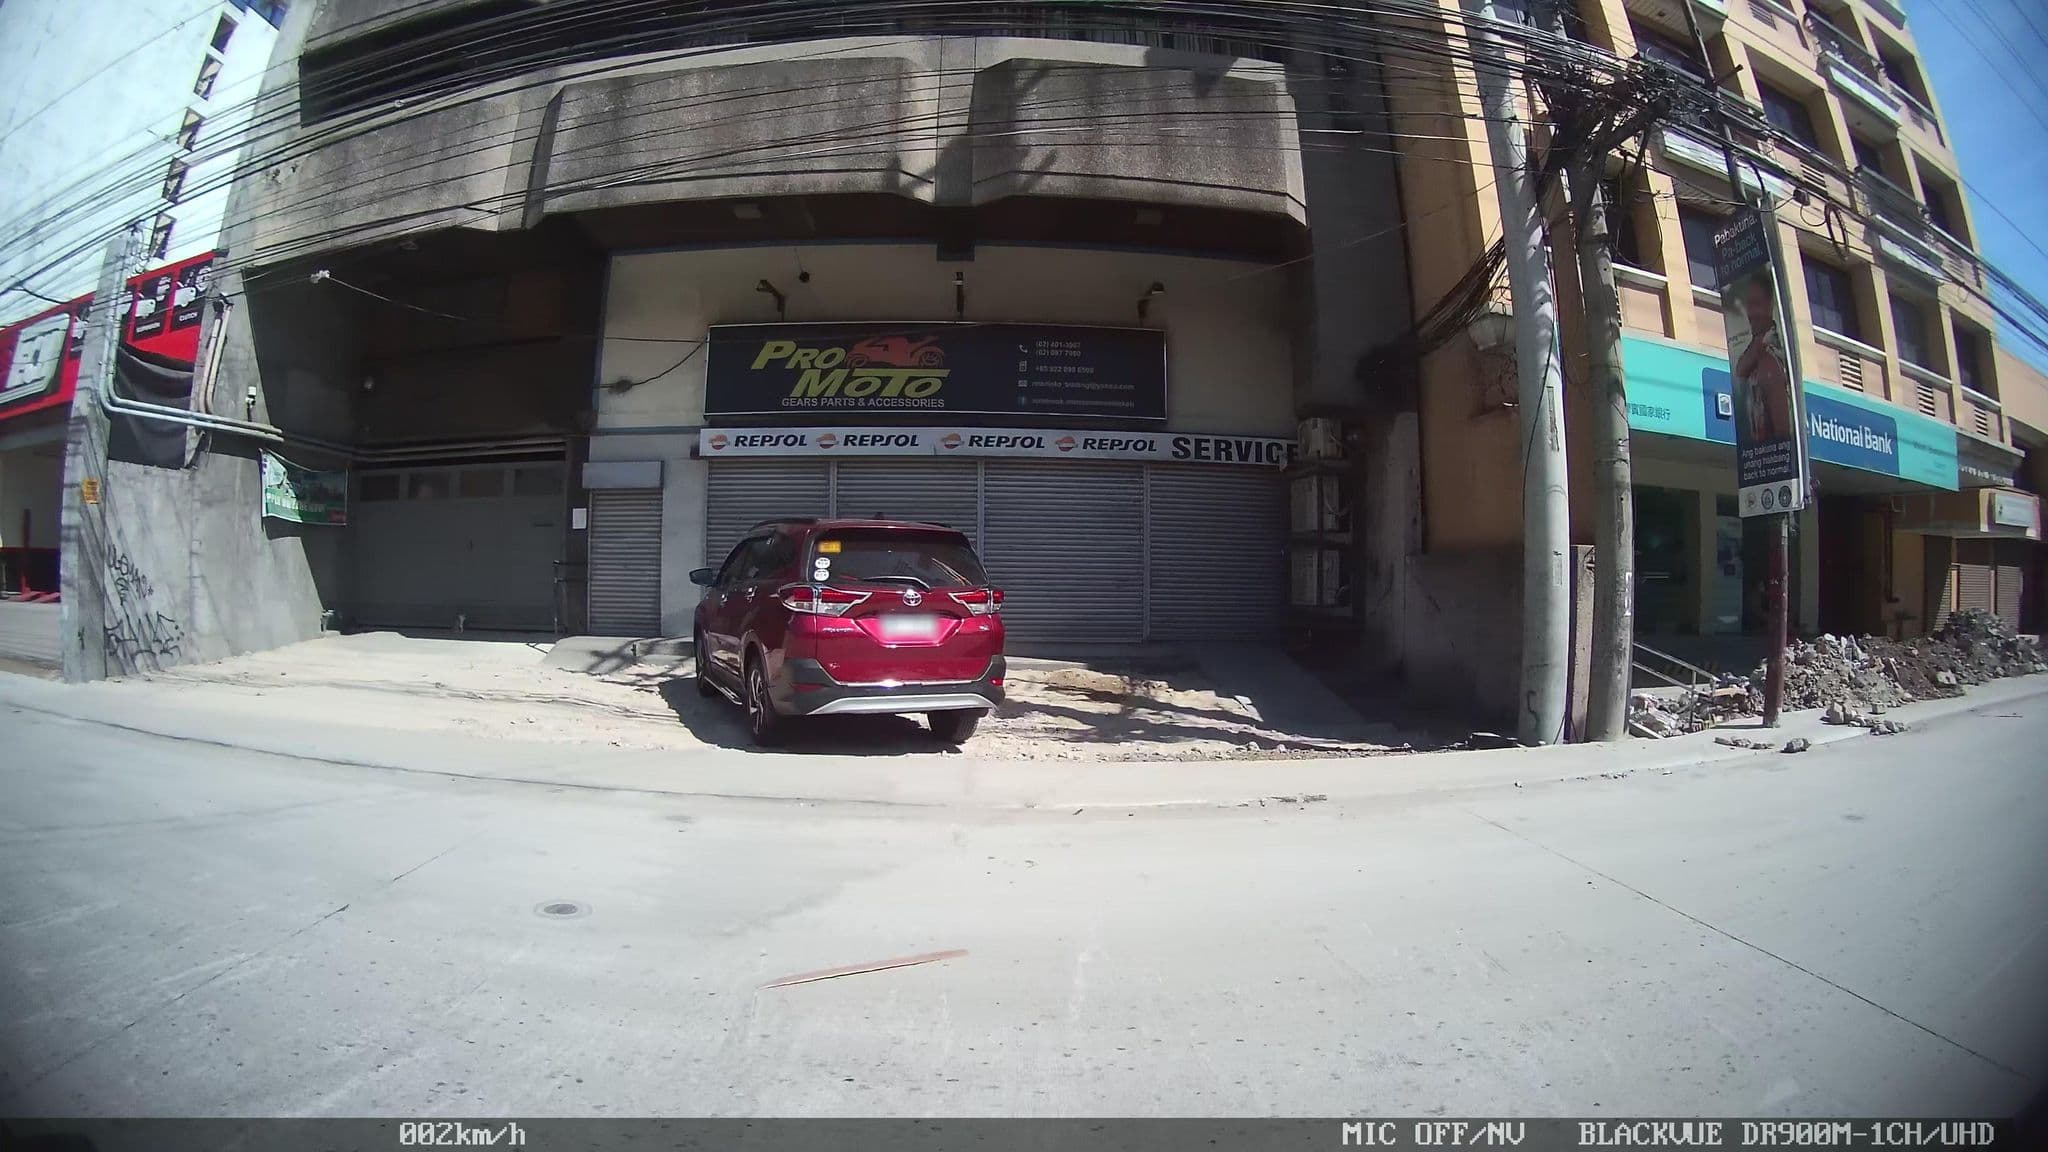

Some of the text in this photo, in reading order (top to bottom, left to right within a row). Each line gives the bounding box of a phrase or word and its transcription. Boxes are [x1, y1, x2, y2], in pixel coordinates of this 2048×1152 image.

[781, 397, 945, 408] GEARS PARTS & ACCESSORIES
[1811, 412, 1863, 447] National
[1864, 427, 1892, 455] Bank
[734, 434, 808, 447] REPSOL
[843, 434, 919, 447] REPSOL
[968, 435, 1046, 449] REPSOL
[1082, 438, 1158, 452] REPSOL
